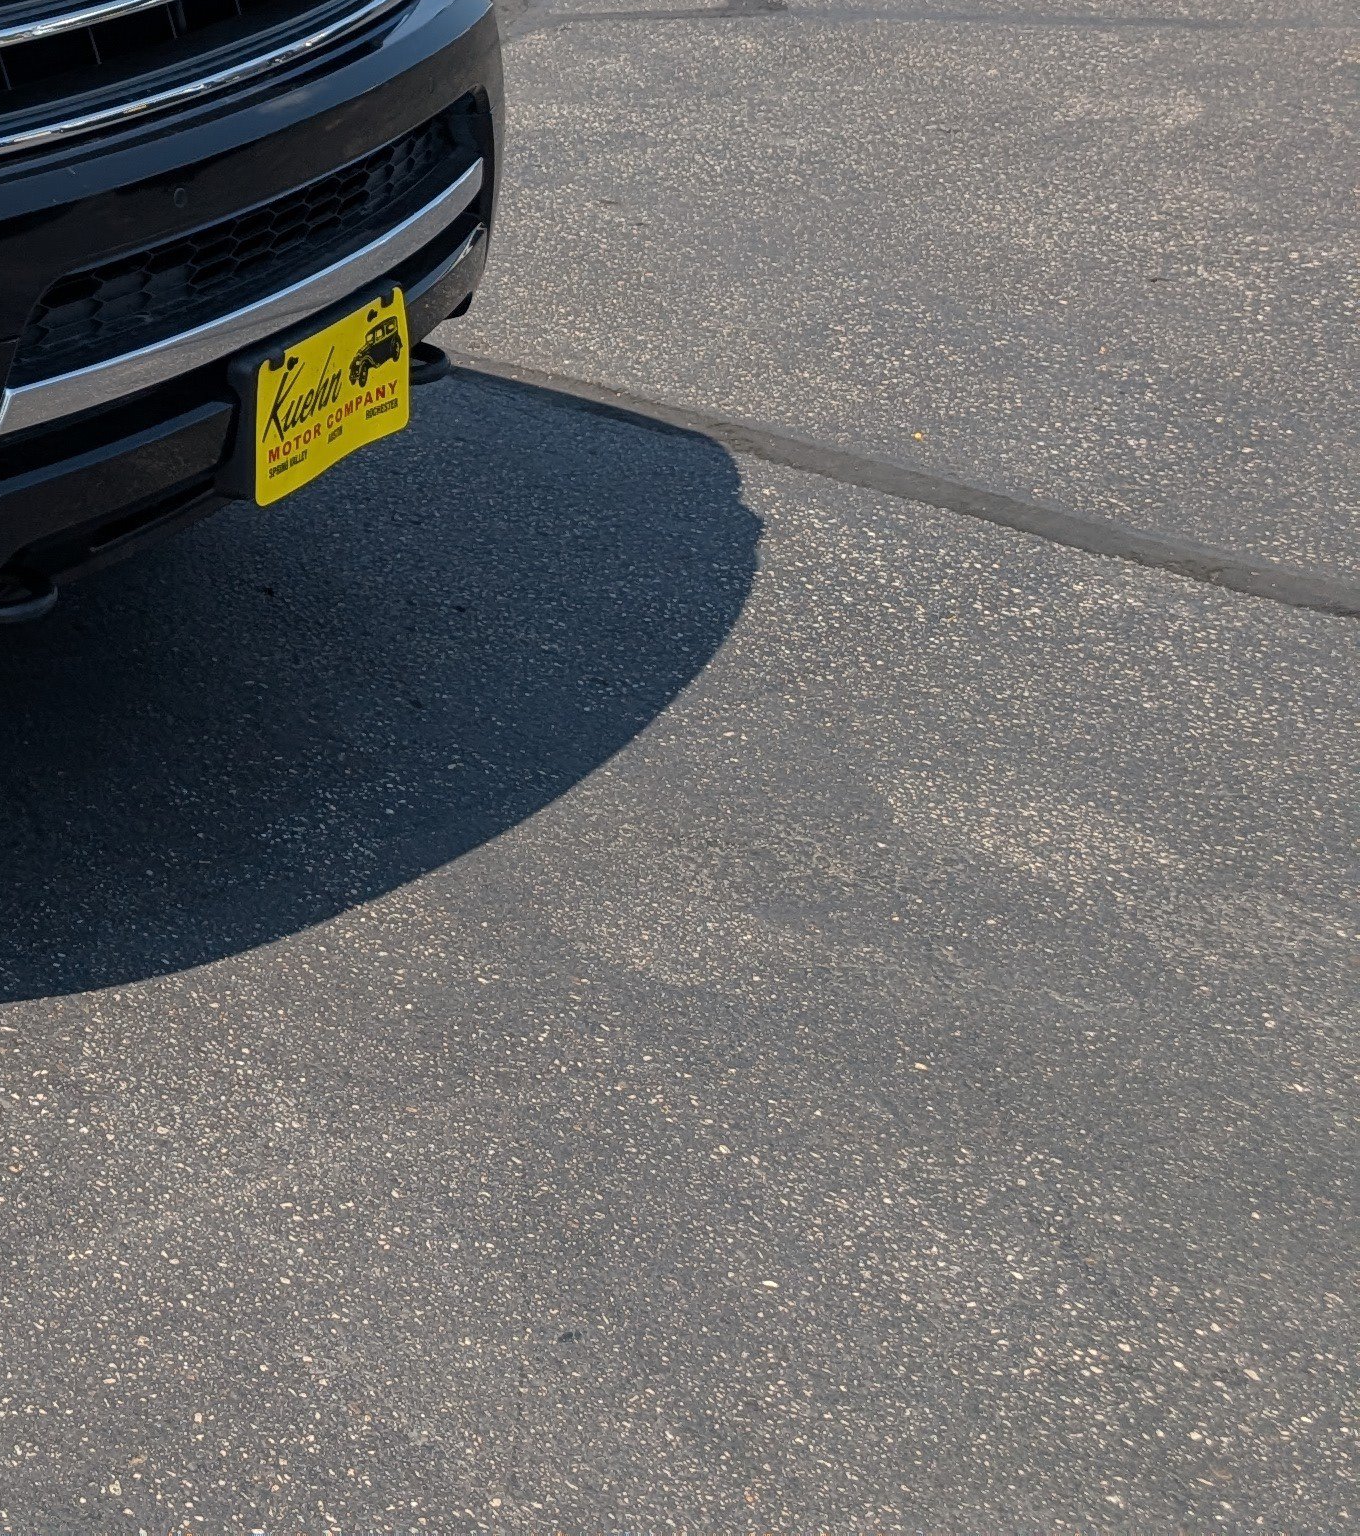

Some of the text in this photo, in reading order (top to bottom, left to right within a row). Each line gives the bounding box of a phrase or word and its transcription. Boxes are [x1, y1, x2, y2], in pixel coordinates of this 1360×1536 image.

[262, 345, 343, 443] Kuehn
[267, 379, 399, 464] MOTOR COMPANY
